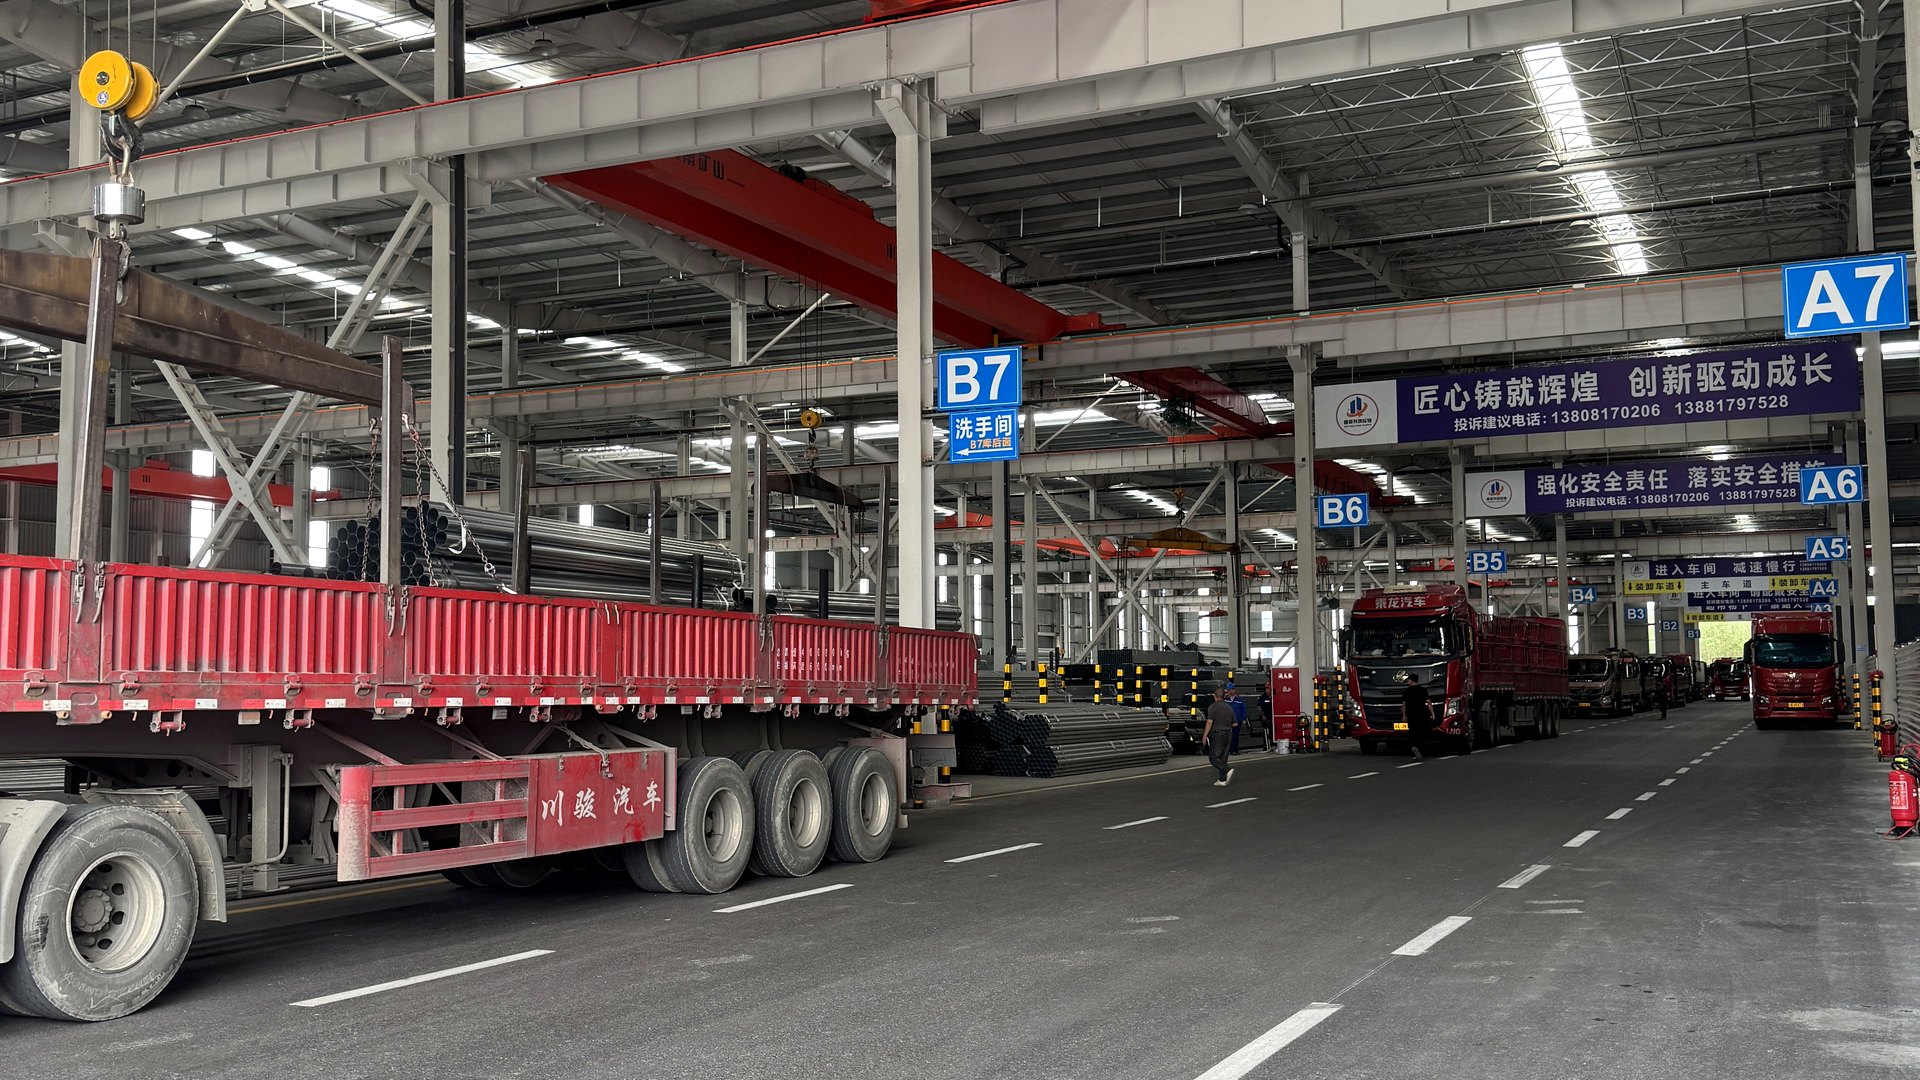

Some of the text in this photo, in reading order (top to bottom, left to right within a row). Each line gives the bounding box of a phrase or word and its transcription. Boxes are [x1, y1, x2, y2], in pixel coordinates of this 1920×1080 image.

[1798, 264, 1896, 328] A7
[947, 355, 1011, 403] B7
[1414, 352, 1833, 415] 匠心铸就辉煌 创新驱动成长
[1674, 395, 1789, 415] 13881797528
[955, 414, 1012, 440] 洗手间
[1537, 468, 1669, 496] 强化安全责任
[1807, 469, 1858, 501] A6
[1719, 488, 1797, 501] 13881797528
[1323, 498, 1364, 525] B6
[1810, 538, 1845, 559] A5
[1473, 552, 1503, 573] B5
[1655, 563, 1717, 576] 进入车间
[1733, 560, 1796, 574] 减速慢行
[1779, 577, 1819, 587] 装卸车
[1812, 580, 1837, 596] A4
[1375, 596, 1426, 609] 乘龙汽车
[1572, 587, 1595, 602] B4
[1627, 608, 1645, 619] B3
[1663, 621, 1677, 631] B2
[1688, 630, 1700, 638] B1
[541, 780, 662, 827] 川骏汽车
